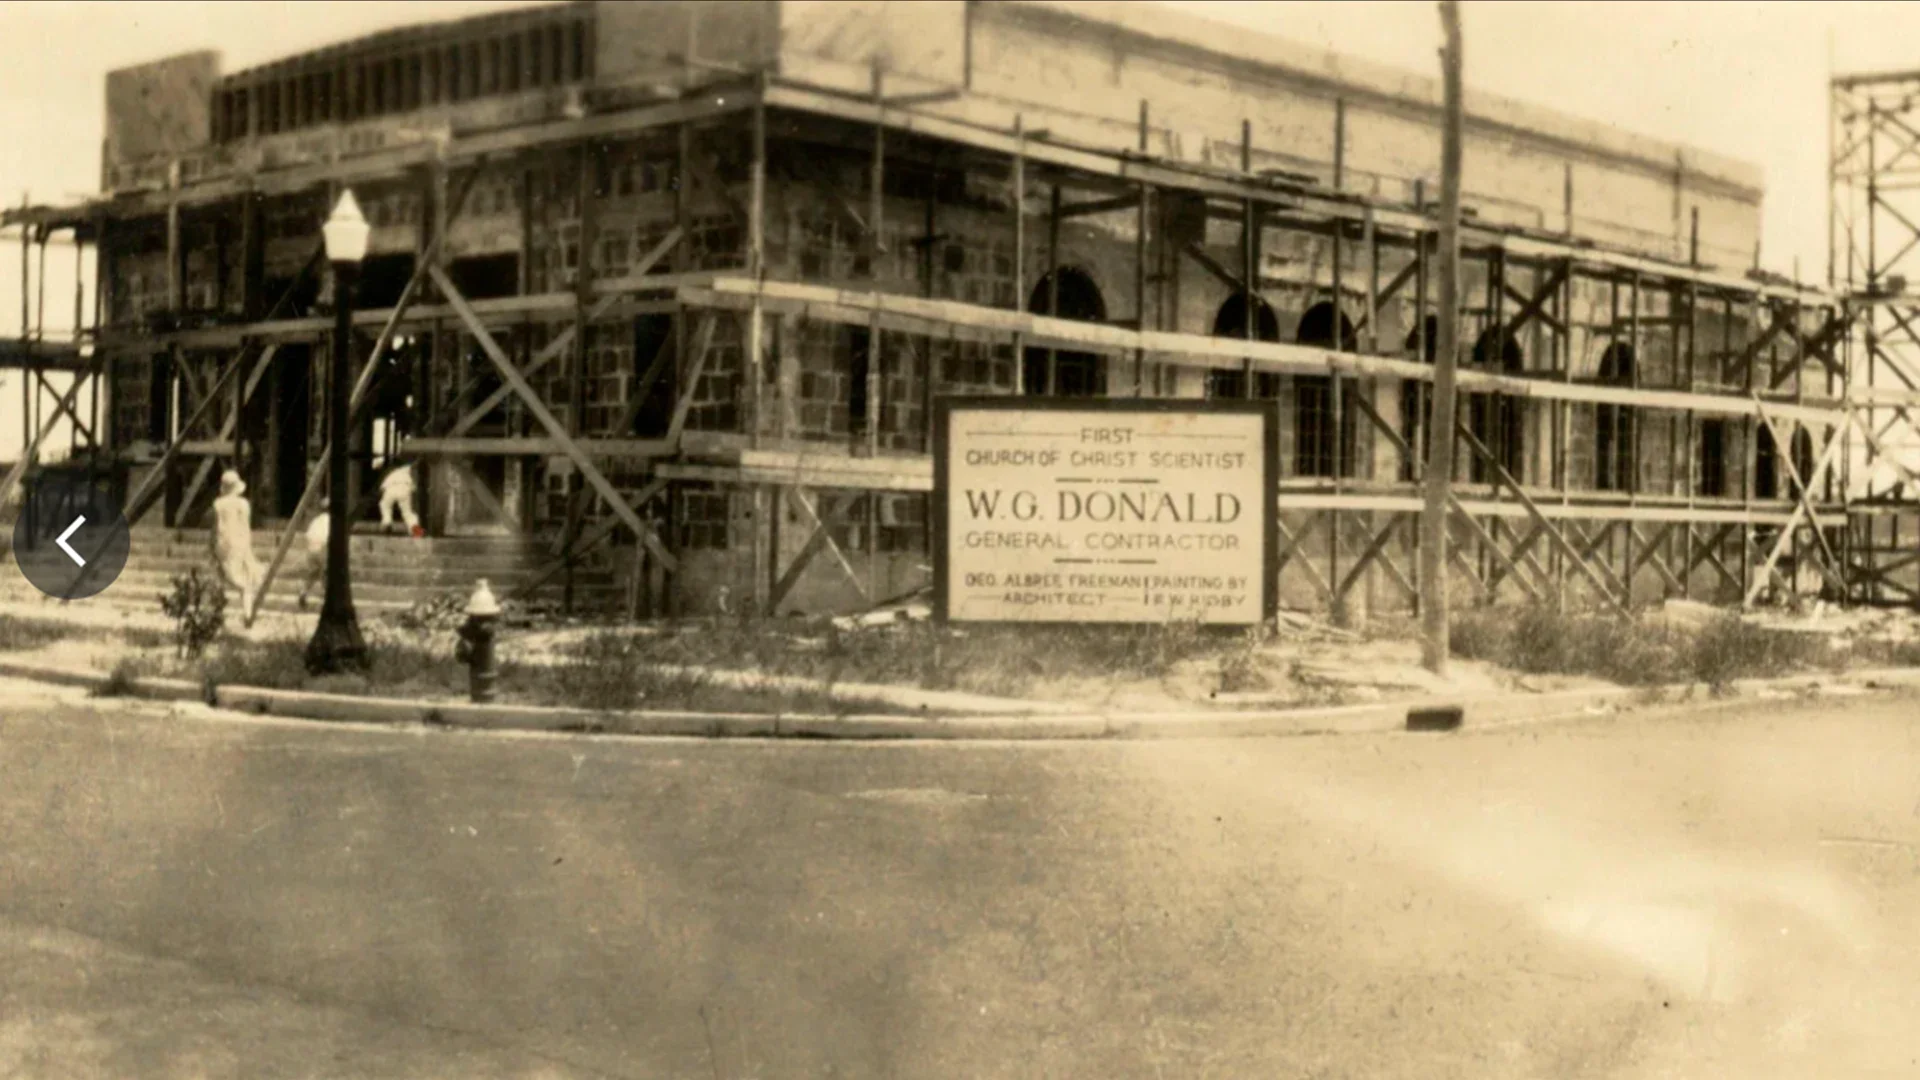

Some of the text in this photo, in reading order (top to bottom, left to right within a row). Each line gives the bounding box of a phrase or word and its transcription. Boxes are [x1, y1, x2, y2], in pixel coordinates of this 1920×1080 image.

[1080, 427, 1135, 444] FIRST
[965, 449, 1245, 470] CHURCH OF CHRIST SCIENTIST
[1057, 490, 1242, 524] DONALD
[965, 530, 1240, 551] GENERAL CONTRACTOR
[1069, 573, 1141, 590] FREEMAN
[1153, 575, 1248, 590] PAINTING BY
[1002, 592, 1107, 606] ARCHITECT
